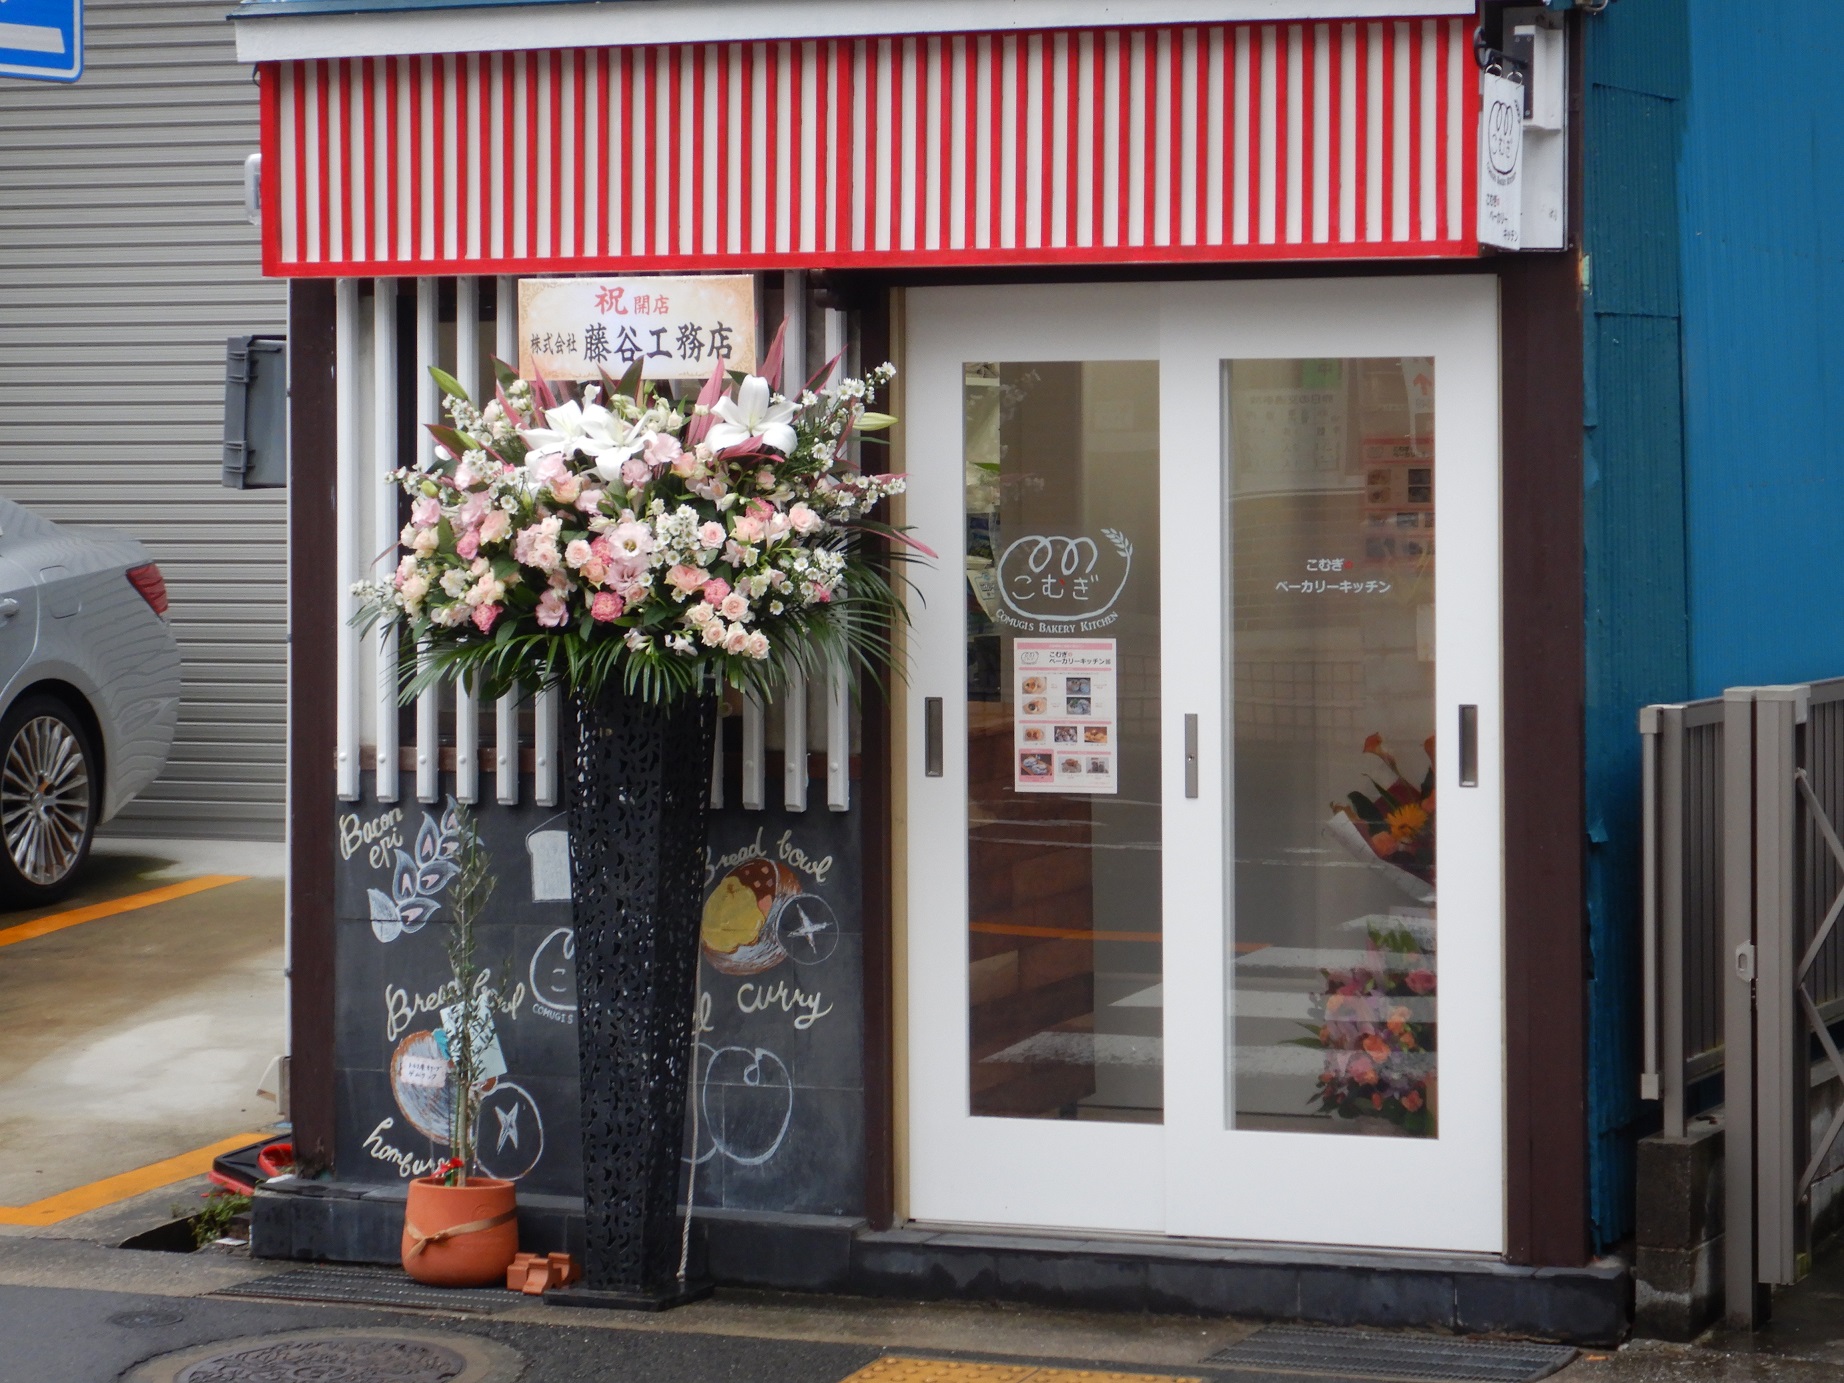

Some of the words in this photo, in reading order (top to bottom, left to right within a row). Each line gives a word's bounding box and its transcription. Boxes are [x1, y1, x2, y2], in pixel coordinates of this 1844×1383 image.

[594, 285, 629, 316] 祝
[633, 295, 670, 315] 開店
[530, 332, 578, 355] 株式会社
[584, 321, 733, 363] 藤谷工務店
[1012, 574, 1099, 600] こむぎ
[1275, 580, 1391, 593] ベーカリーキッチン
[1039, 622, 1076, 633] BAKERY
[1081, 611, 1118, 632] KITCHEN
[339, 808, 403, 860] Bacon
[776, 829, 833, 882] bowl
[737, 980, 833, 1030] curry
